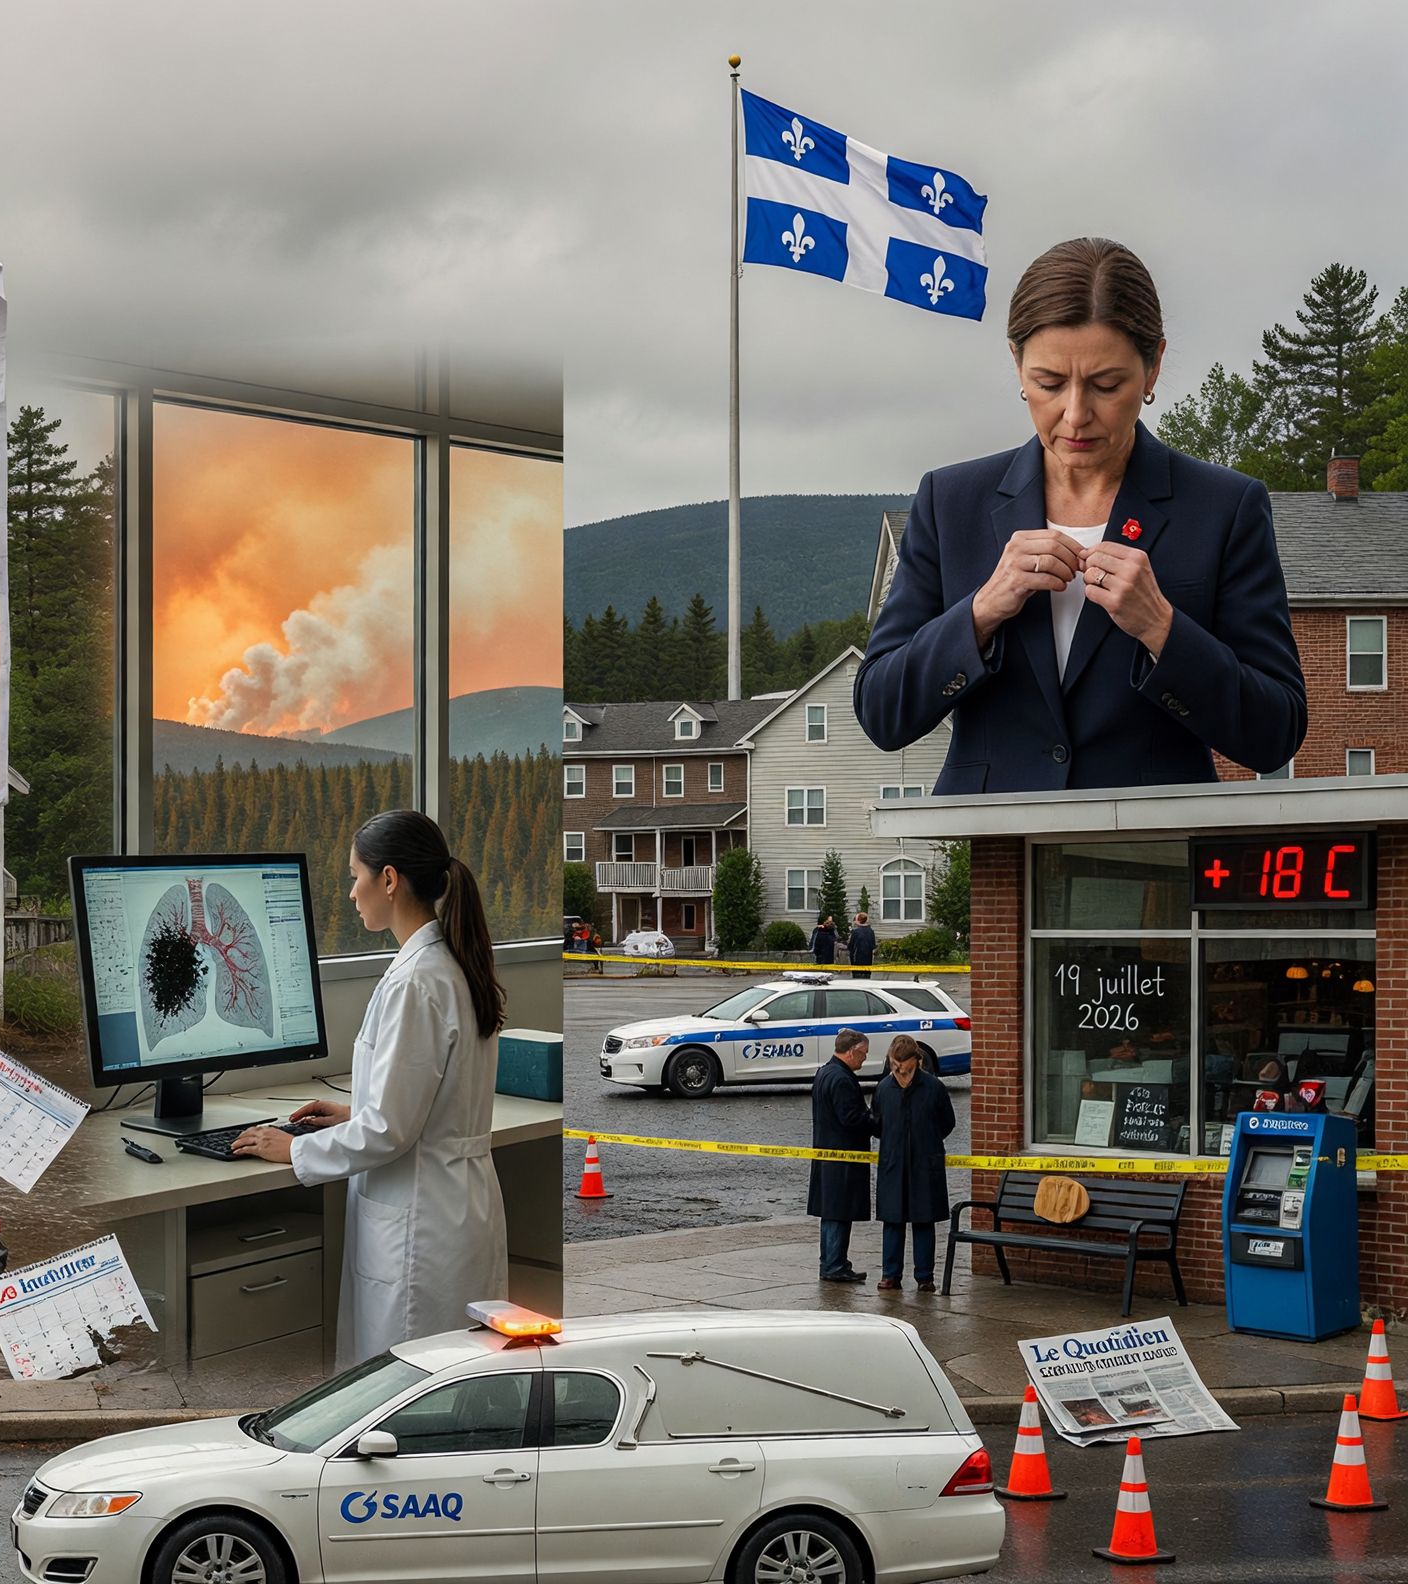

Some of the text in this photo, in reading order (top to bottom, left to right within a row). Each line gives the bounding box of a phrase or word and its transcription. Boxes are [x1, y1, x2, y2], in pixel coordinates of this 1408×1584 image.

[1260, 846, 1304, 898] 18
[1324, 845, 1356, 898] C
[1054, 963, 1166, 1005] 19 juillet
[1078, 1003, 1140, 1031] 2026
[1030, 1344, 1060, 1363] Le
[380, 1492, 464, 1522] SAAQ
